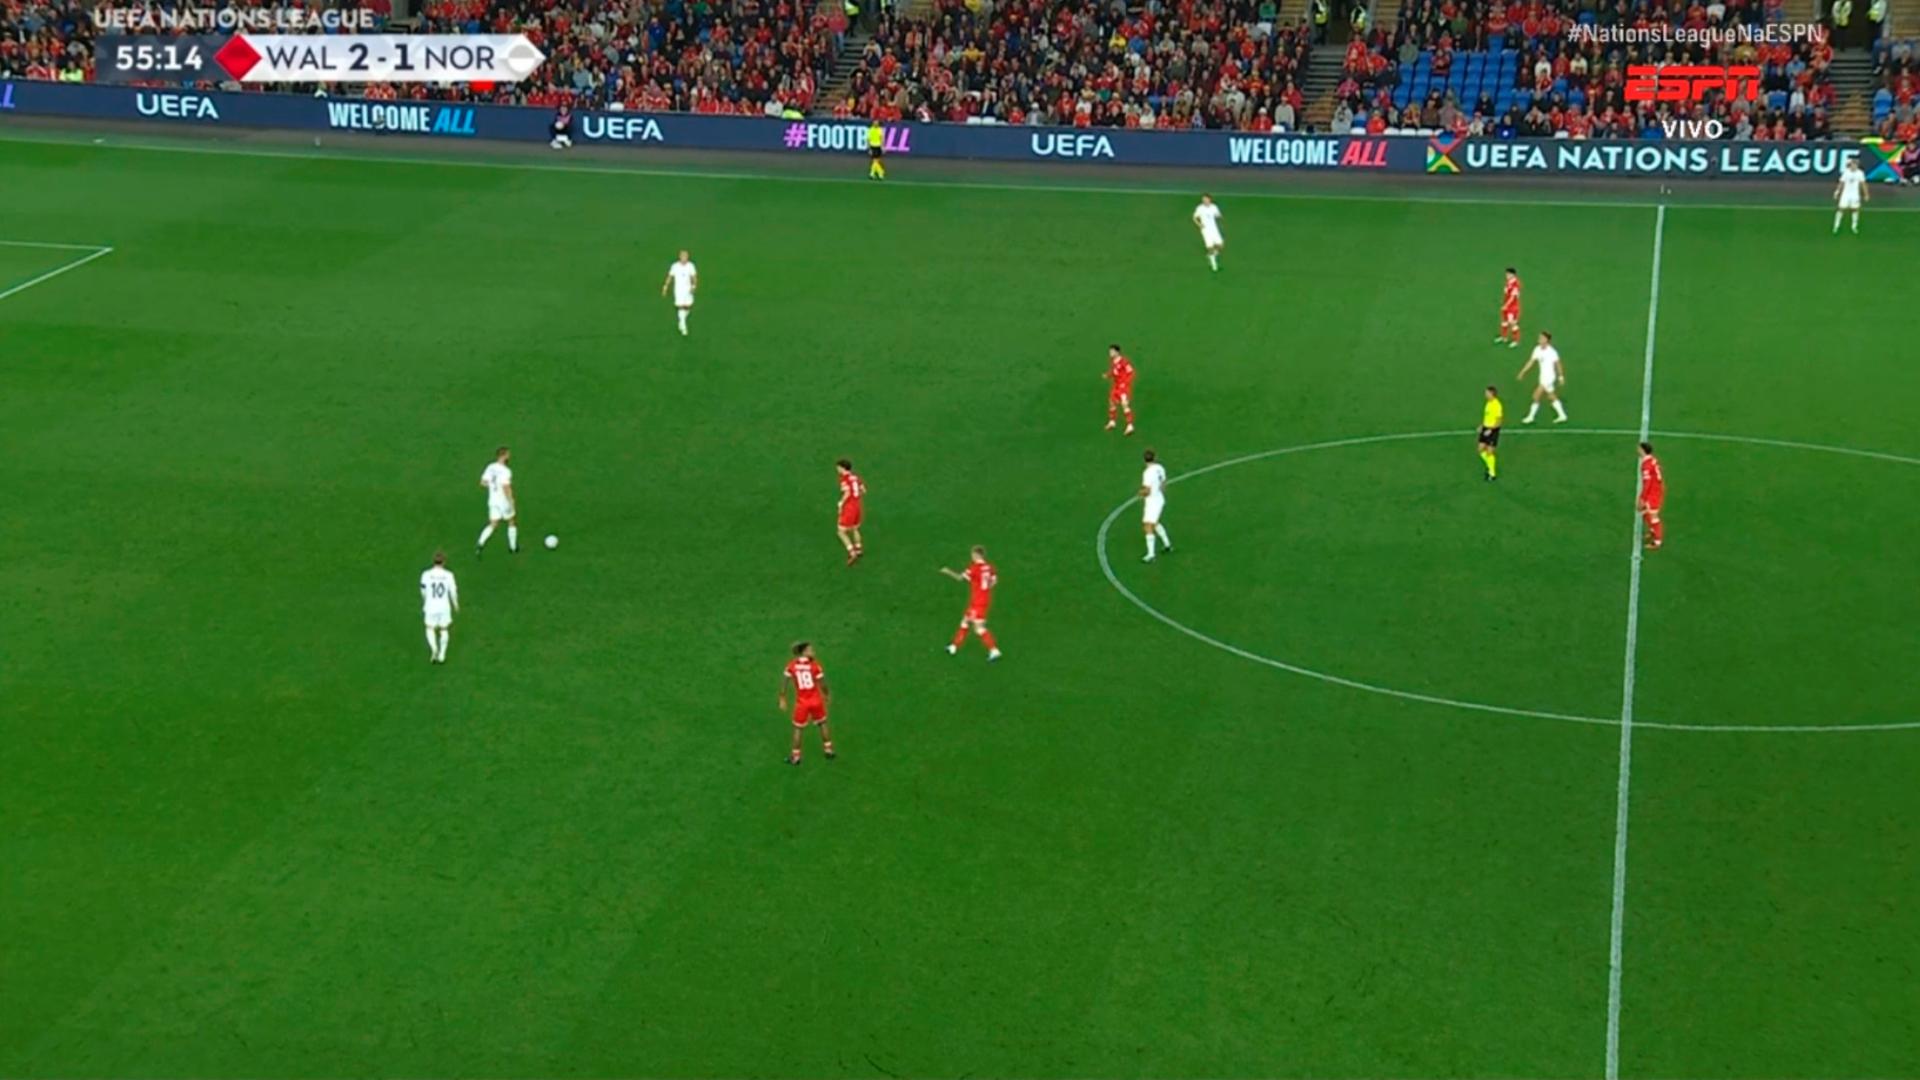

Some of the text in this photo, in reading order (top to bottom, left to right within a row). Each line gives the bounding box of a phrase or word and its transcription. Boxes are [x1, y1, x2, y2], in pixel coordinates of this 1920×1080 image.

[136, 93, 219, 119] UEFA
[328, 102, 475, 134] WELCOME ALL
[583, 116, 664, 141] UEFA
[783, 122, 910, 152] #FOOTBLL
[1032, 133, 1115, 157] UEFA
[1229, 137, 1387, 166] WELCOME ALL
[1466, 144, 1548, 169] UEFA
[1557, 146, 1709, 172] NATIONS
[431, 582, 446, 598] 10
